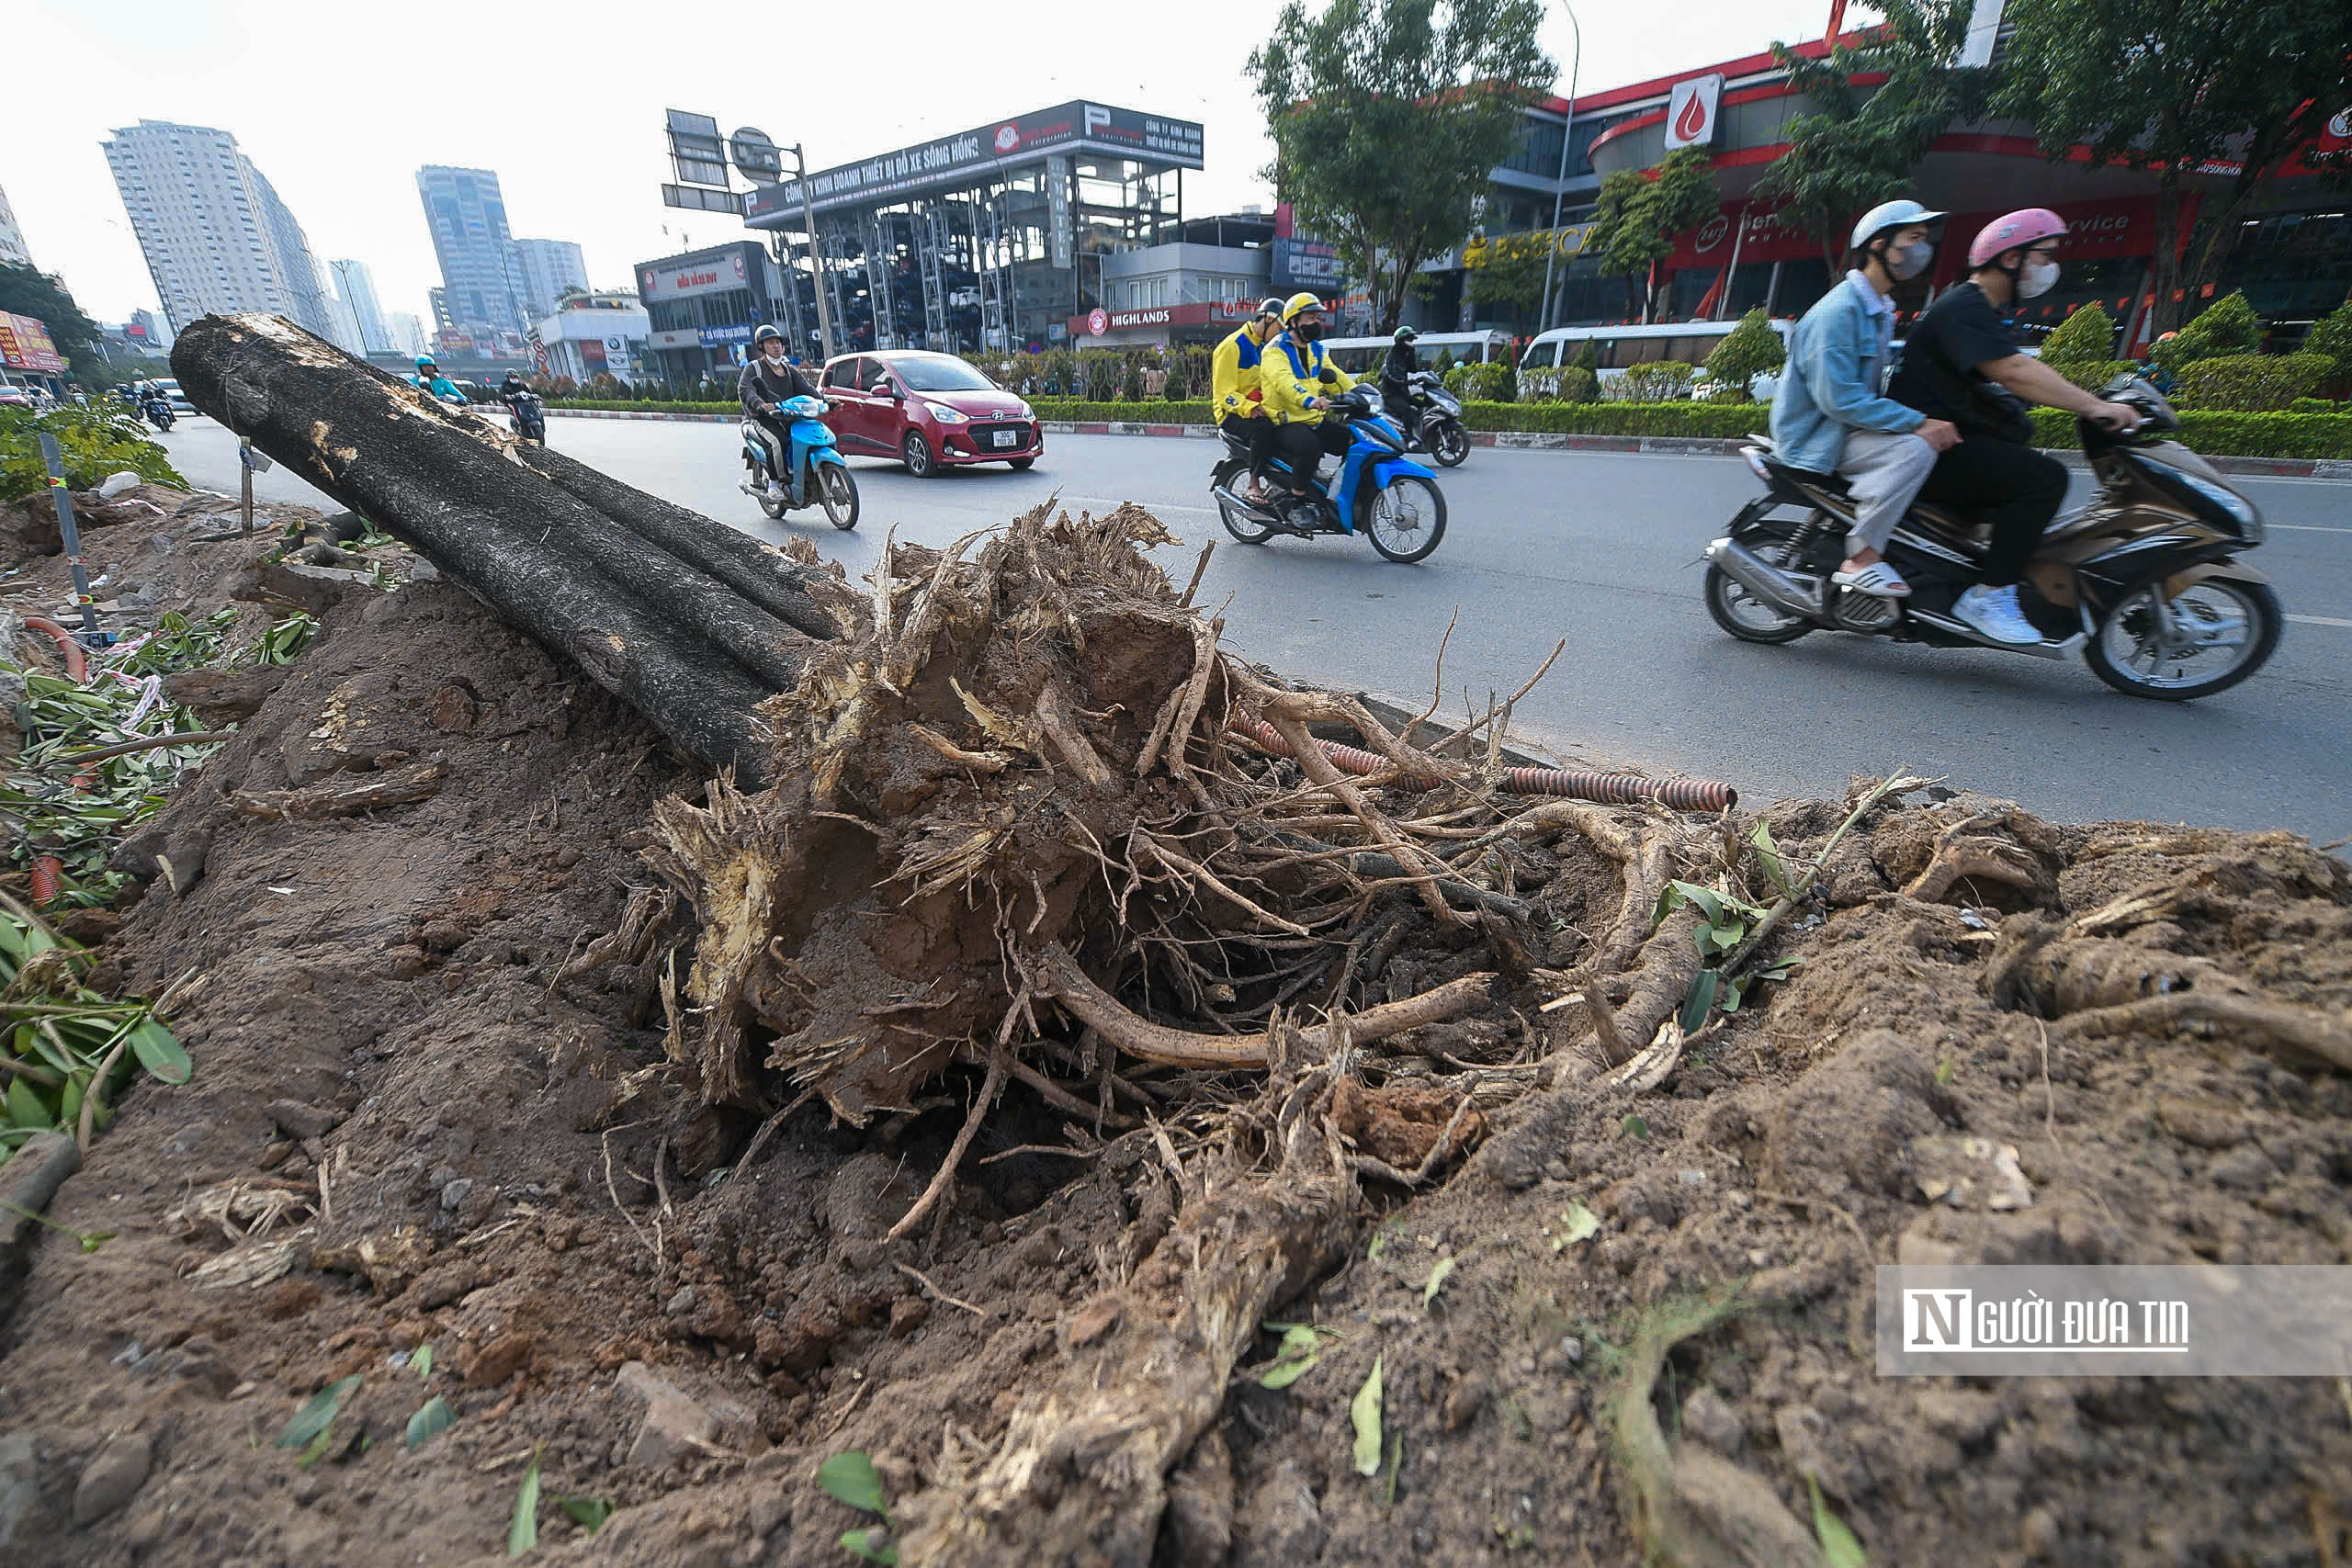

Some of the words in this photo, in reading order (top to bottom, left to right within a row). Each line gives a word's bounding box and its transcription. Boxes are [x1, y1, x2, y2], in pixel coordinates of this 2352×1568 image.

[814, 175, 833, 196] KINH
[833, 168, 861, 191] DOANH
[910, 152, 922, 172] XE
[923, 144, 950, 169] SÔNG
[1112, 310, 1170, 327] HIGHLANDS
